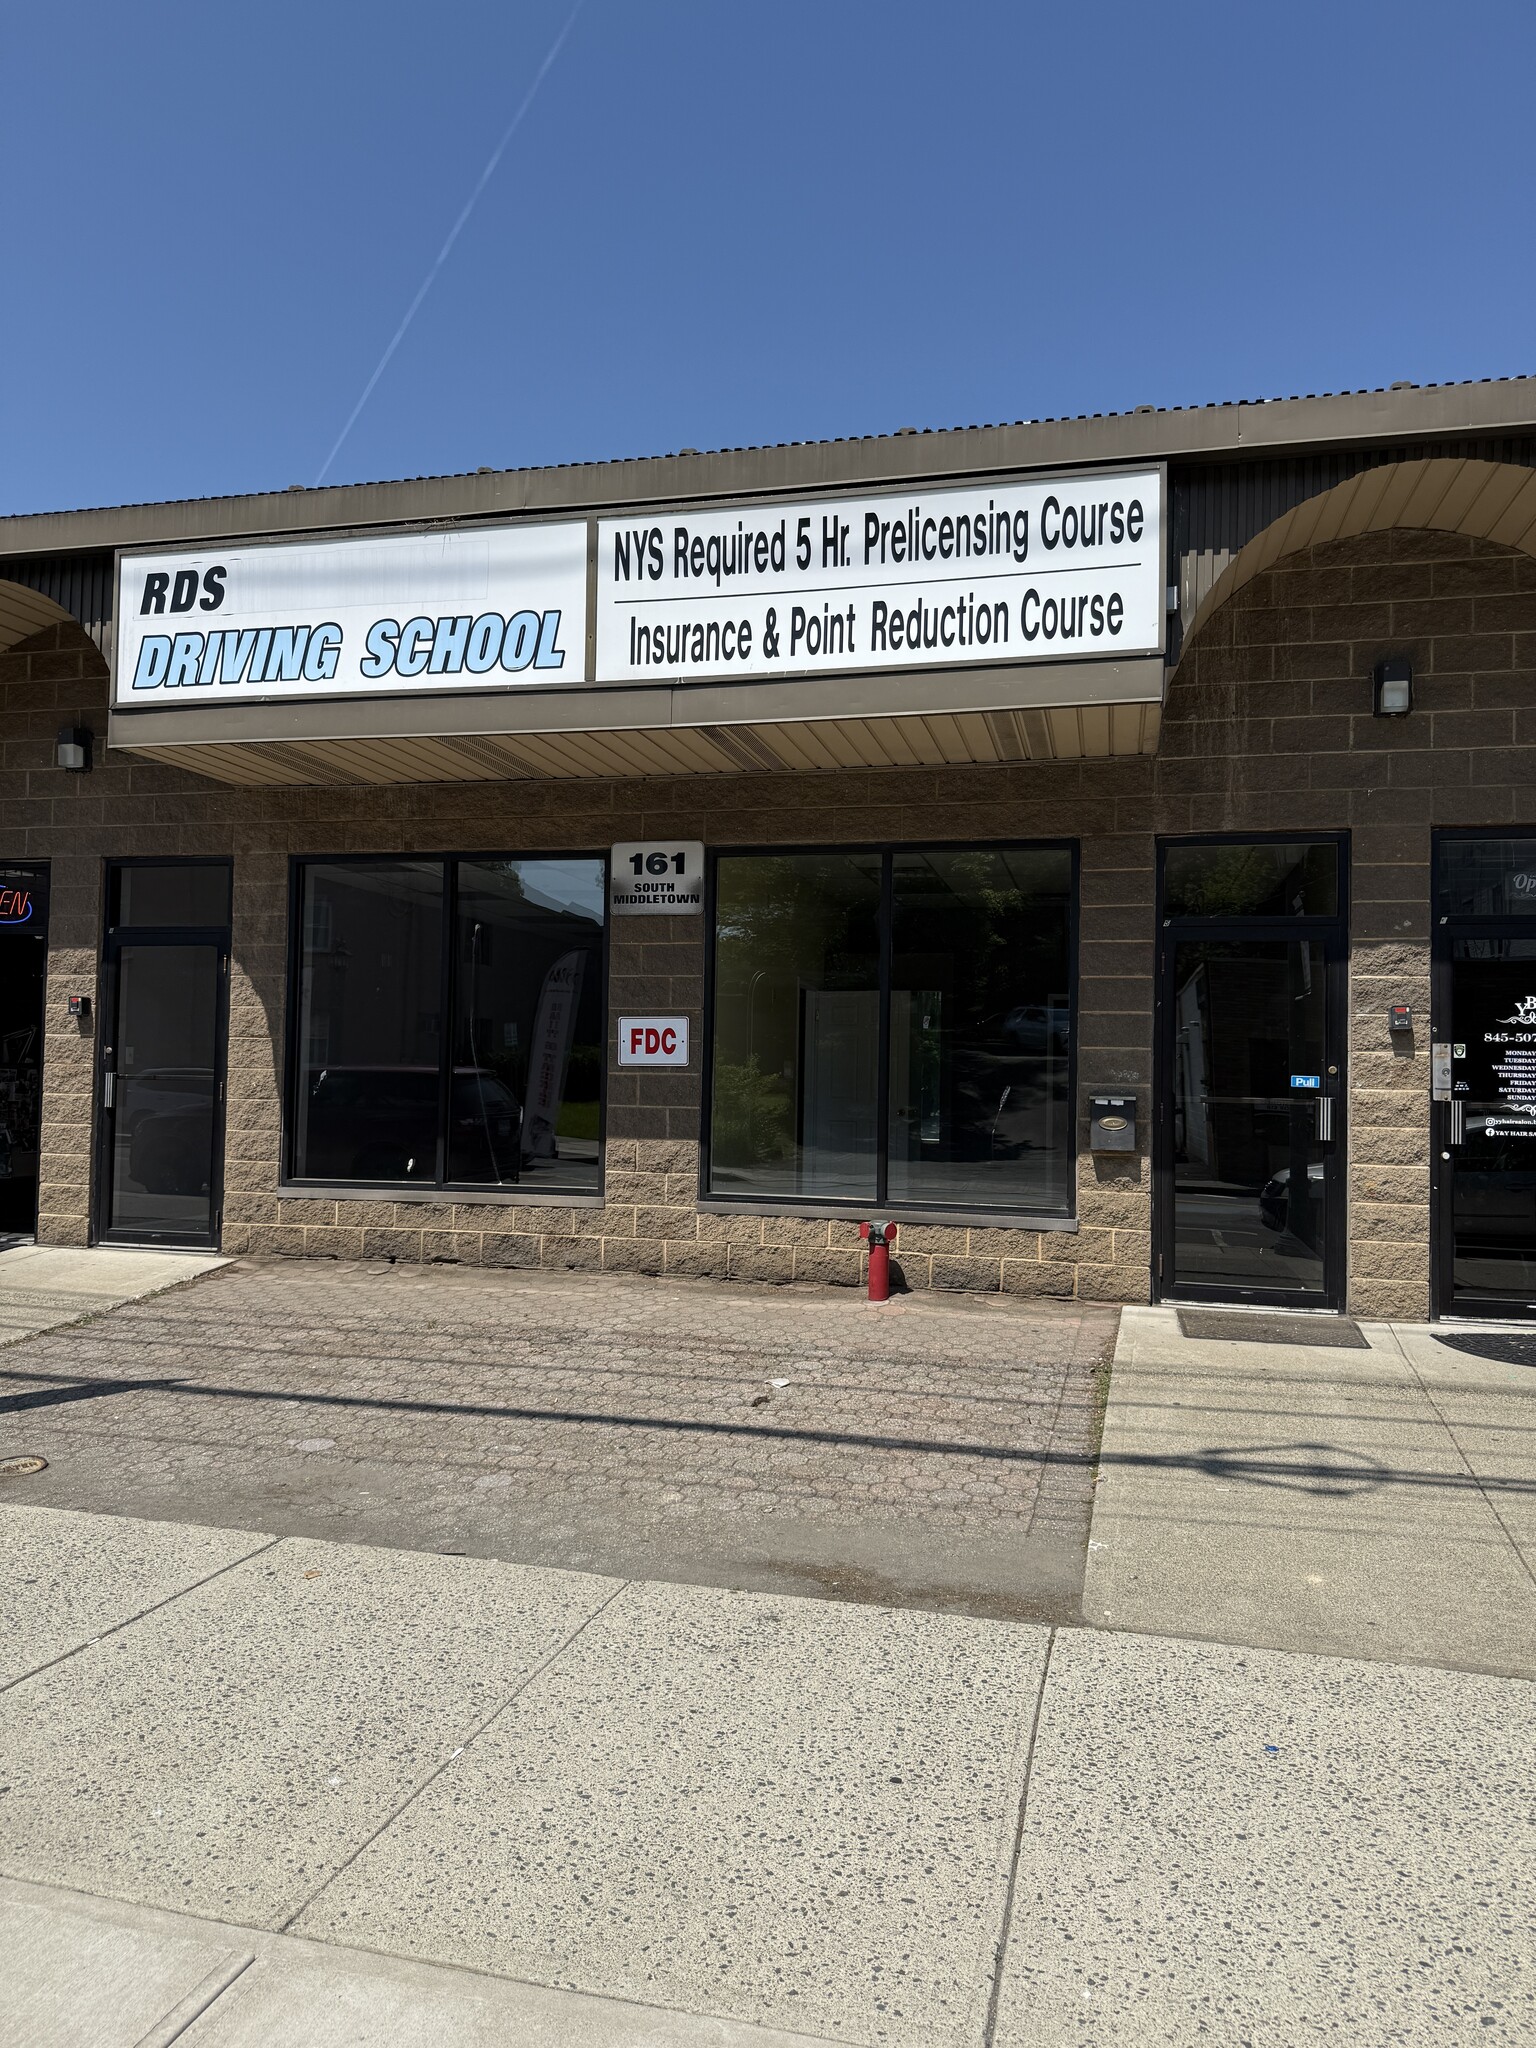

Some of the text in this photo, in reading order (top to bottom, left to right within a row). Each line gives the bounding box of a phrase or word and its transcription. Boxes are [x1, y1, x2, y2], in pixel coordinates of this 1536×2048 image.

[613, 495, 1145, 588] NYS Required 5 Hr. Prelicensing Course
[139, 565, 228, 616] RDS
[629, 588, 1124, 666] Insurance & Point Reduction Course
[132, 609, 566, 690] DRIVING SCHOOL
[629, 852, 686, 876] 161
[613, 894, 700, 904] MIDDLETOWN
[634, 882, 675, 893] SOUTH
[630, 1027, 677, 1055] FDC
[1295, 1077, 1315, 1087] Pull
